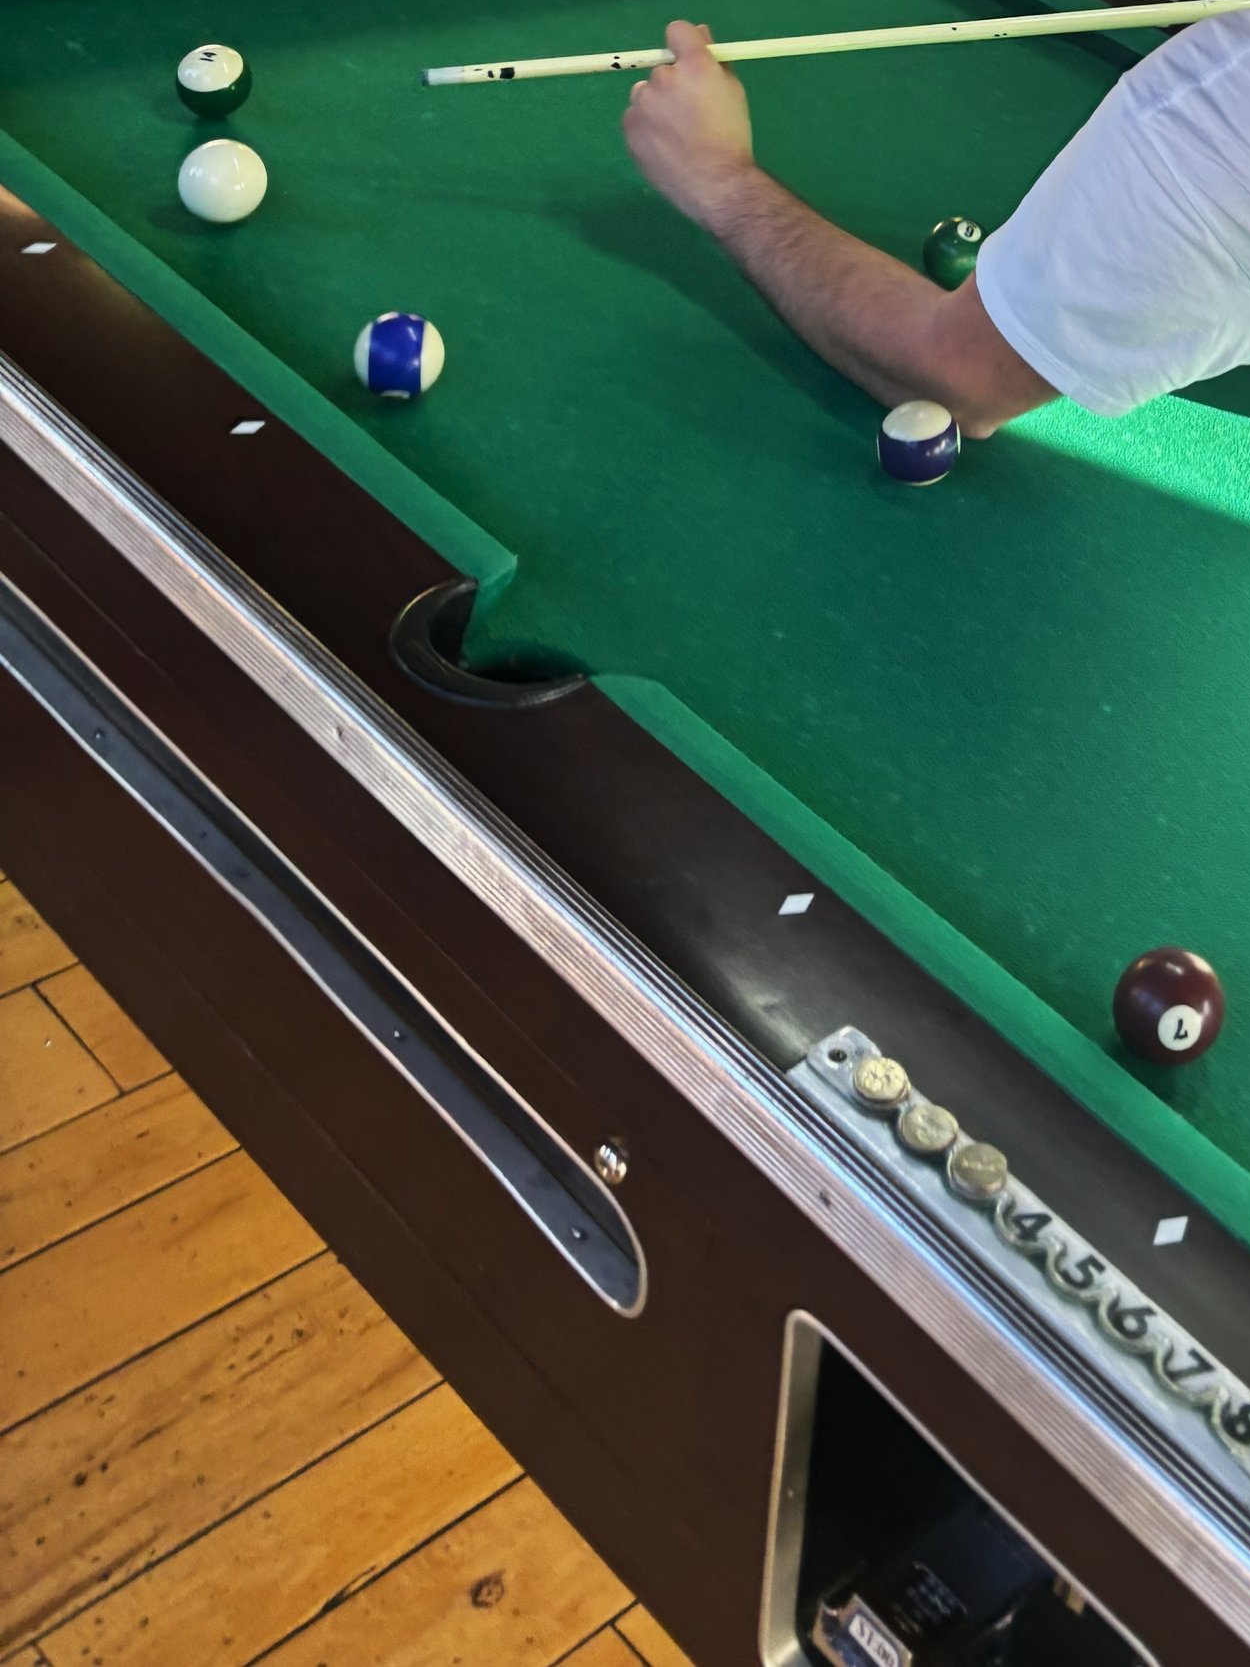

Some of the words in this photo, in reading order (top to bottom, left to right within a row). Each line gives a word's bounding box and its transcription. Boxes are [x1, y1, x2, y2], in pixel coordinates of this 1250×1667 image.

[1173, 1018, 1188, 1040] 7
[1014, 1213, 1052, 1241] 4
[1066, 1254, 1106, 1289] 5
[1114, 1306, 1157, 1340] 6
[1169, 1348, 1215, 1383] 7
